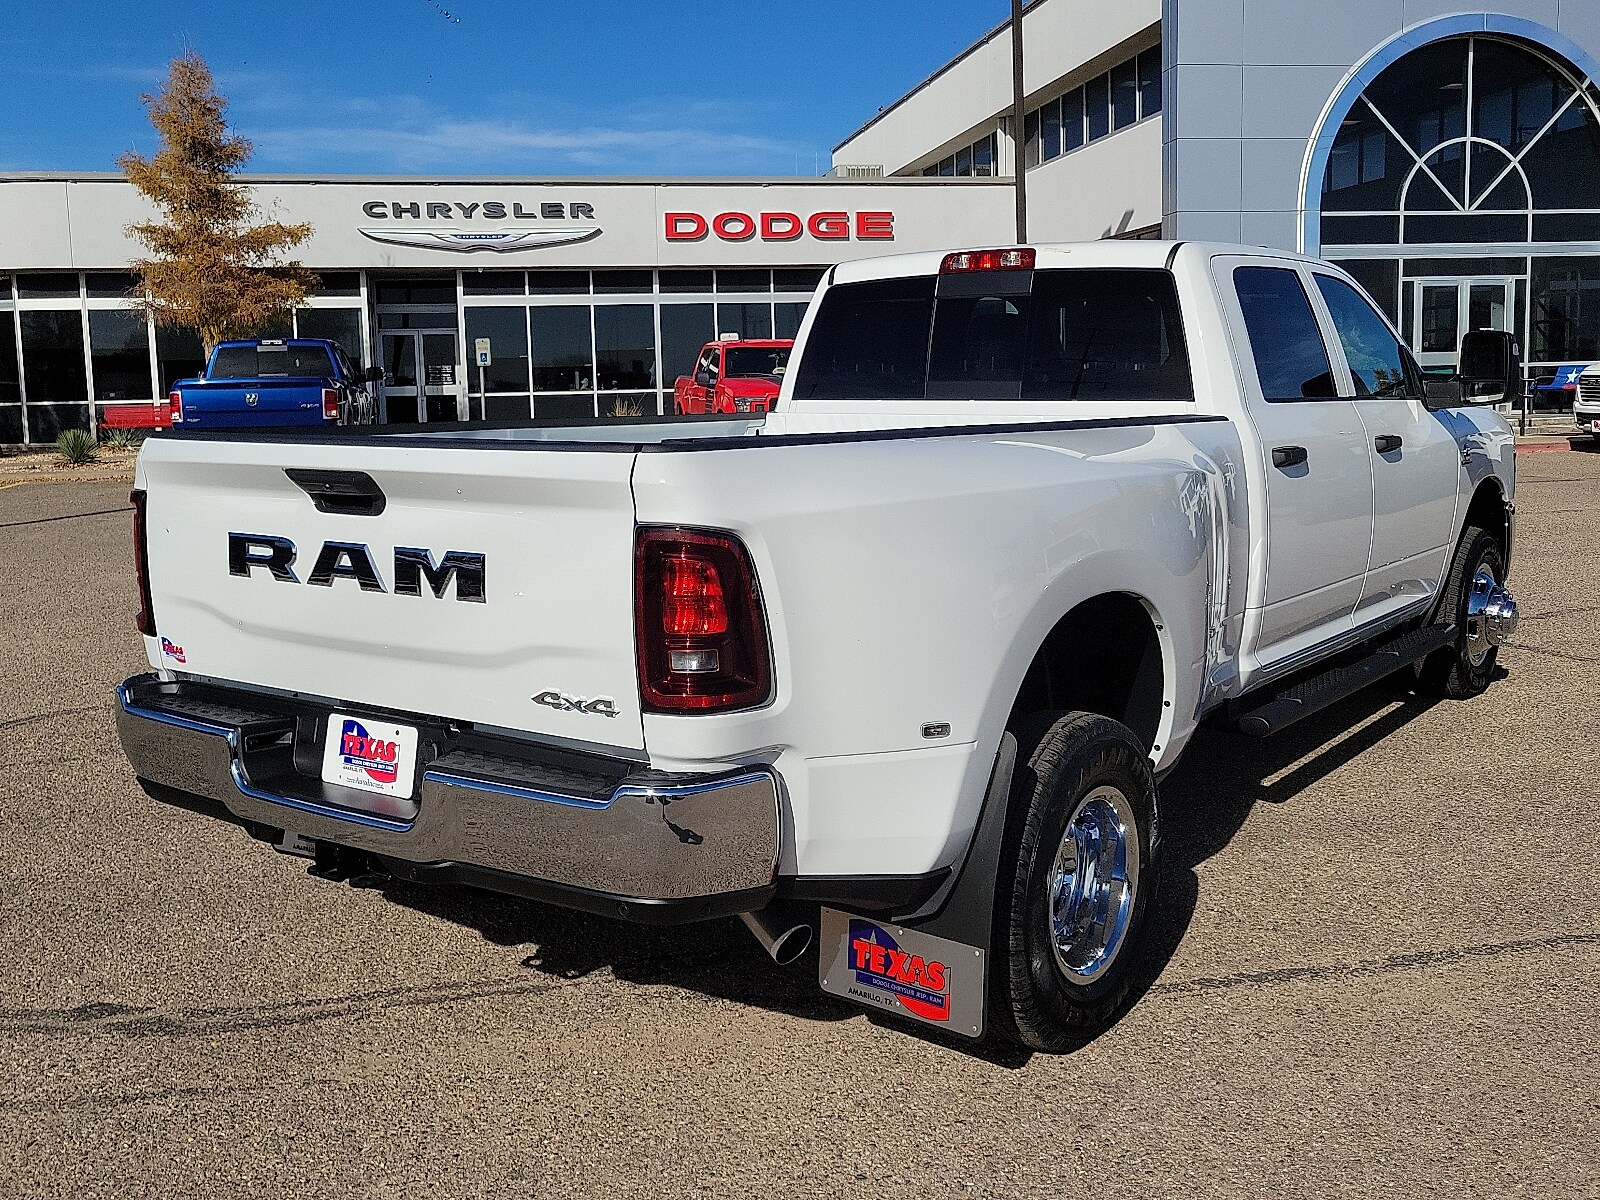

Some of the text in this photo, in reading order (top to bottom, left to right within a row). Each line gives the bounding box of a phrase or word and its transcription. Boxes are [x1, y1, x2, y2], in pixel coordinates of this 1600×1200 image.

[362, 201, 596, 220] CHRYSLER
[664, 211, 895, 243] DODGE
[228, 532, 487, 604] RAM
[343, 733, 397, 762] TEXAS
[853, 939, 945, 991] TEXAS
[884, 997, 893, 1006] TX
